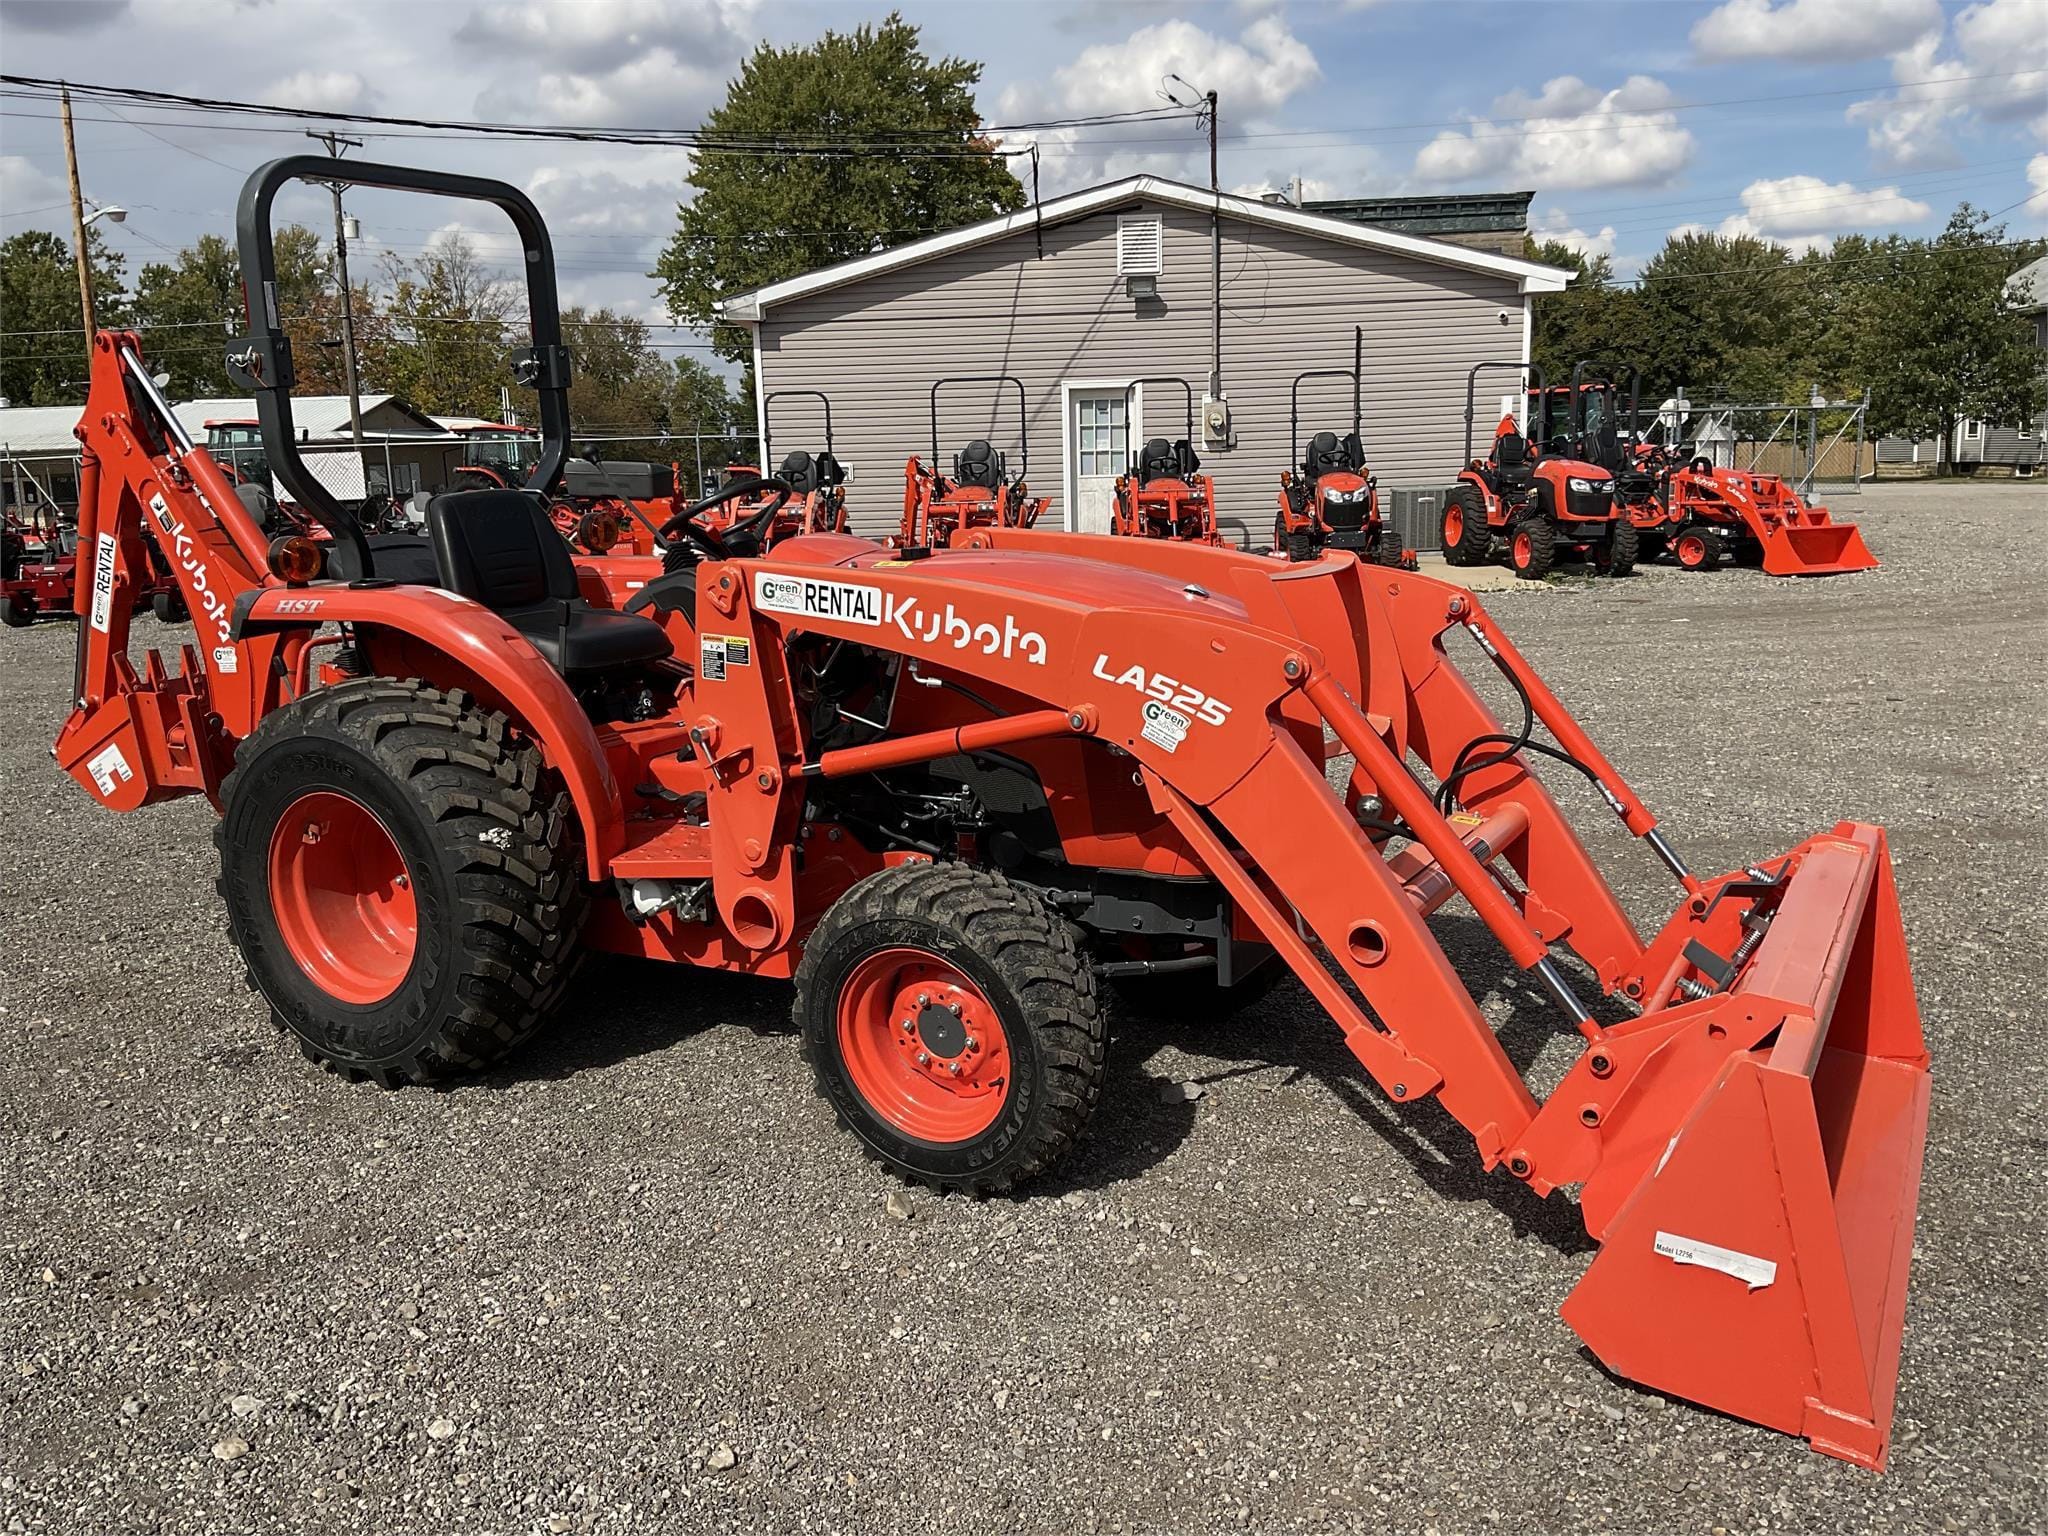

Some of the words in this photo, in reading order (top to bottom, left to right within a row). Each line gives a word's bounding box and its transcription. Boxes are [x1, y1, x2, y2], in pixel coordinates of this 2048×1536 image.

[97, 540, 114, 595] RENTAL
[171, 522, 231, 643] Kubota
[273, 599, 325, 614] HST
[763, 581, 798, 599] Green
[805, 583, 878, 621] RENTAL
[884, 592, 1047, 666] Kubota
[1092, 653, 1233, 727] LA525
[1145, 703, 1185, 728] Green
[1656, 1243, 1674, 1254] Model
